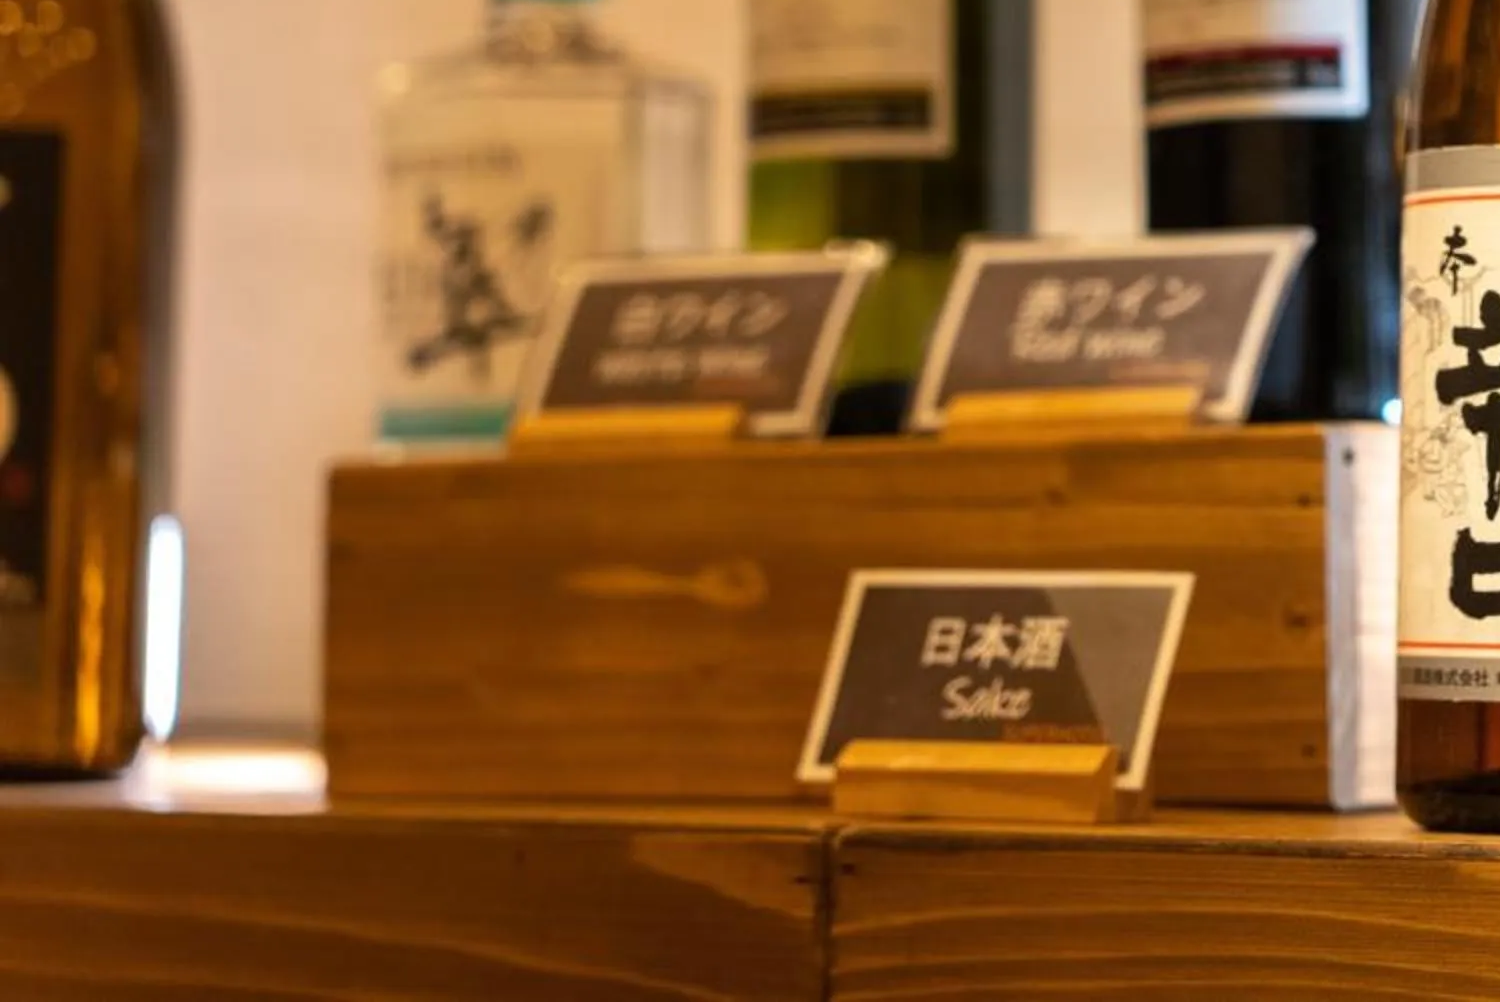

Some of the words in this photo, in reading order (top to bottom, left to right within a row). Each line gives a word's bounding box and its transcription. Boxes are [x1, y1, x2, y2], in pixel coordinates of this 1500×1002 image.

[921, 612, 1069, 671] 日本酒
[941, 676, 1032, 719] Sake
